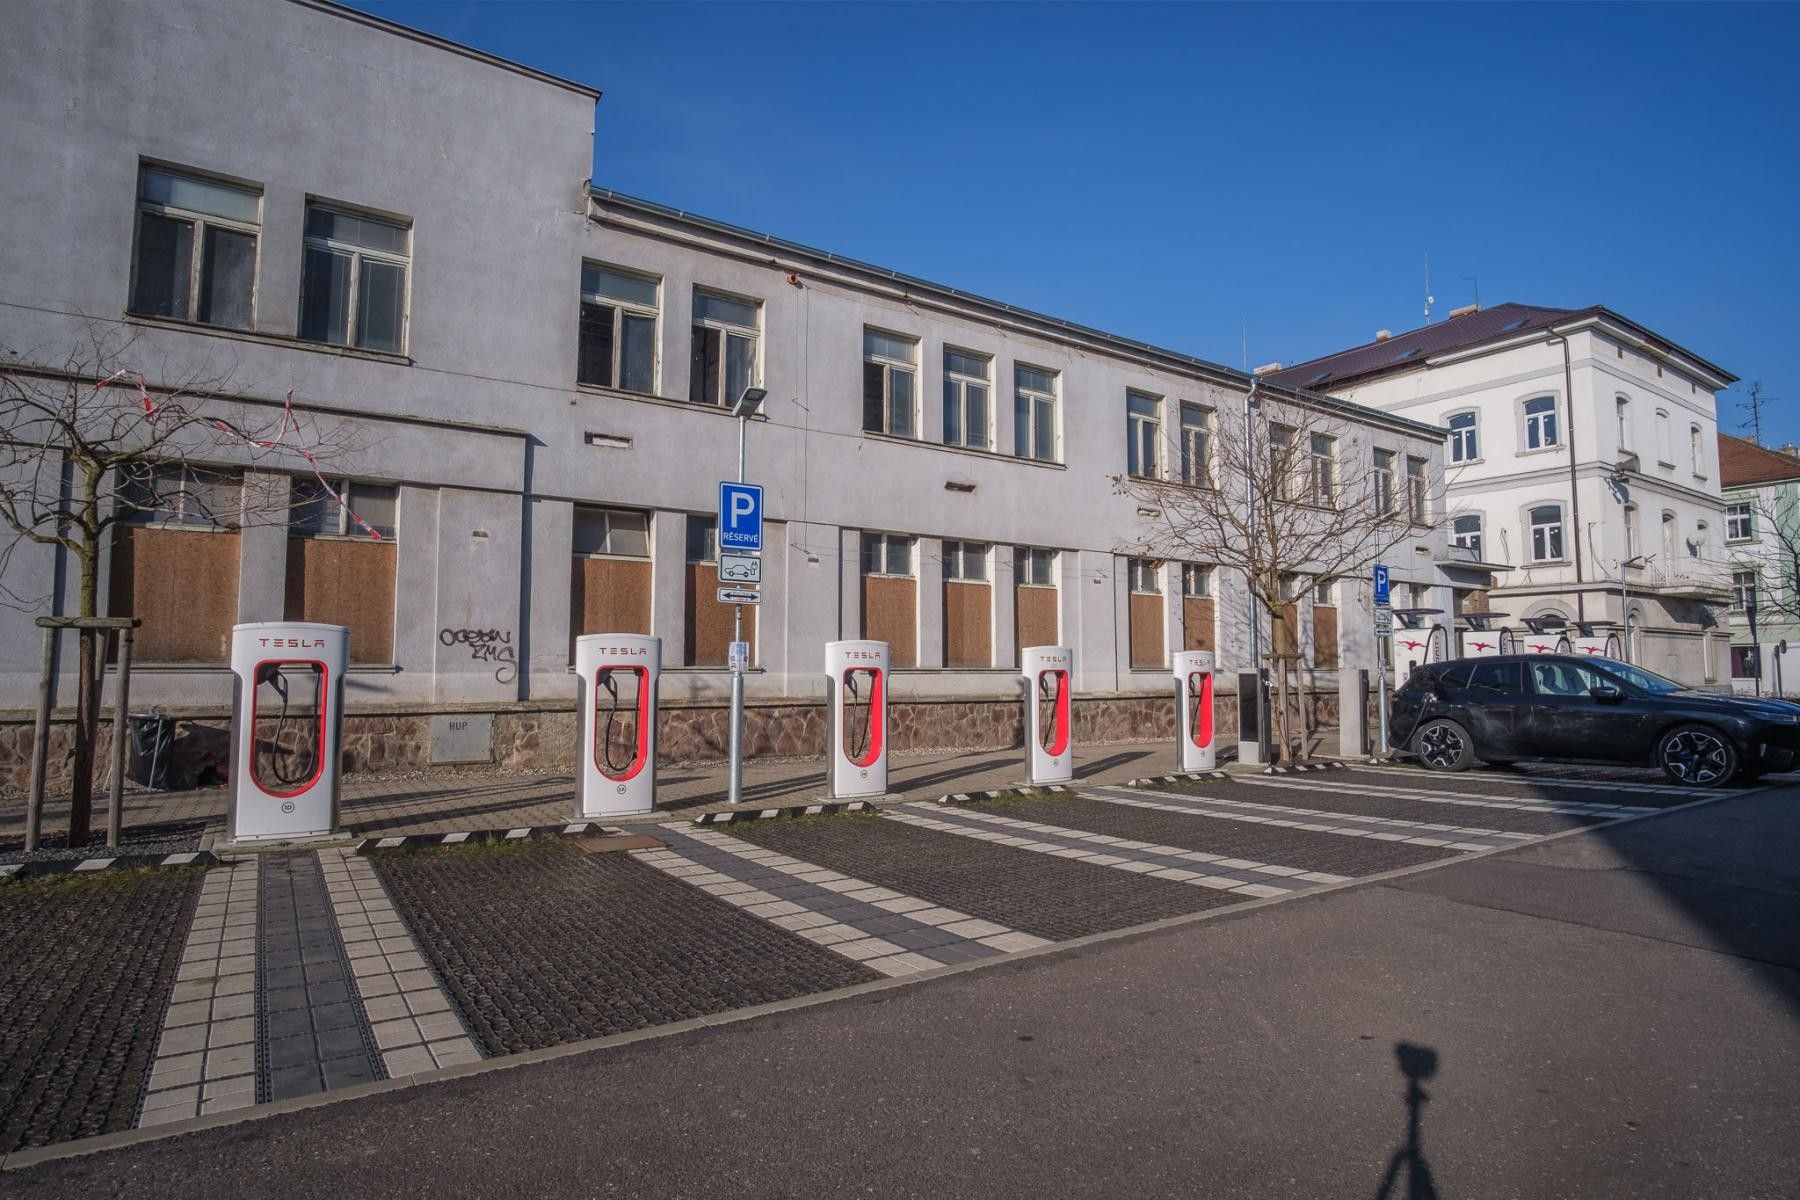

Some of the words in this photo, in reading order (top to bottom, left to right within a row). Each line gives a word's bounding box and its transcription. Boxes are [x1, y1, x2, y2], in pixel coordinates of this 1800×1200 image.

[731, 491, 755, 528] P
[723, 531, 759, 543] RÉSERVÉ
[1377, 570, 1387, 592] P
[258, 638, 325, 648] TESLA
[599, 647, 647, 655] TESLA
[845, 651, 881, 660] TESLA
[449, 721, 468, 731] HUP
